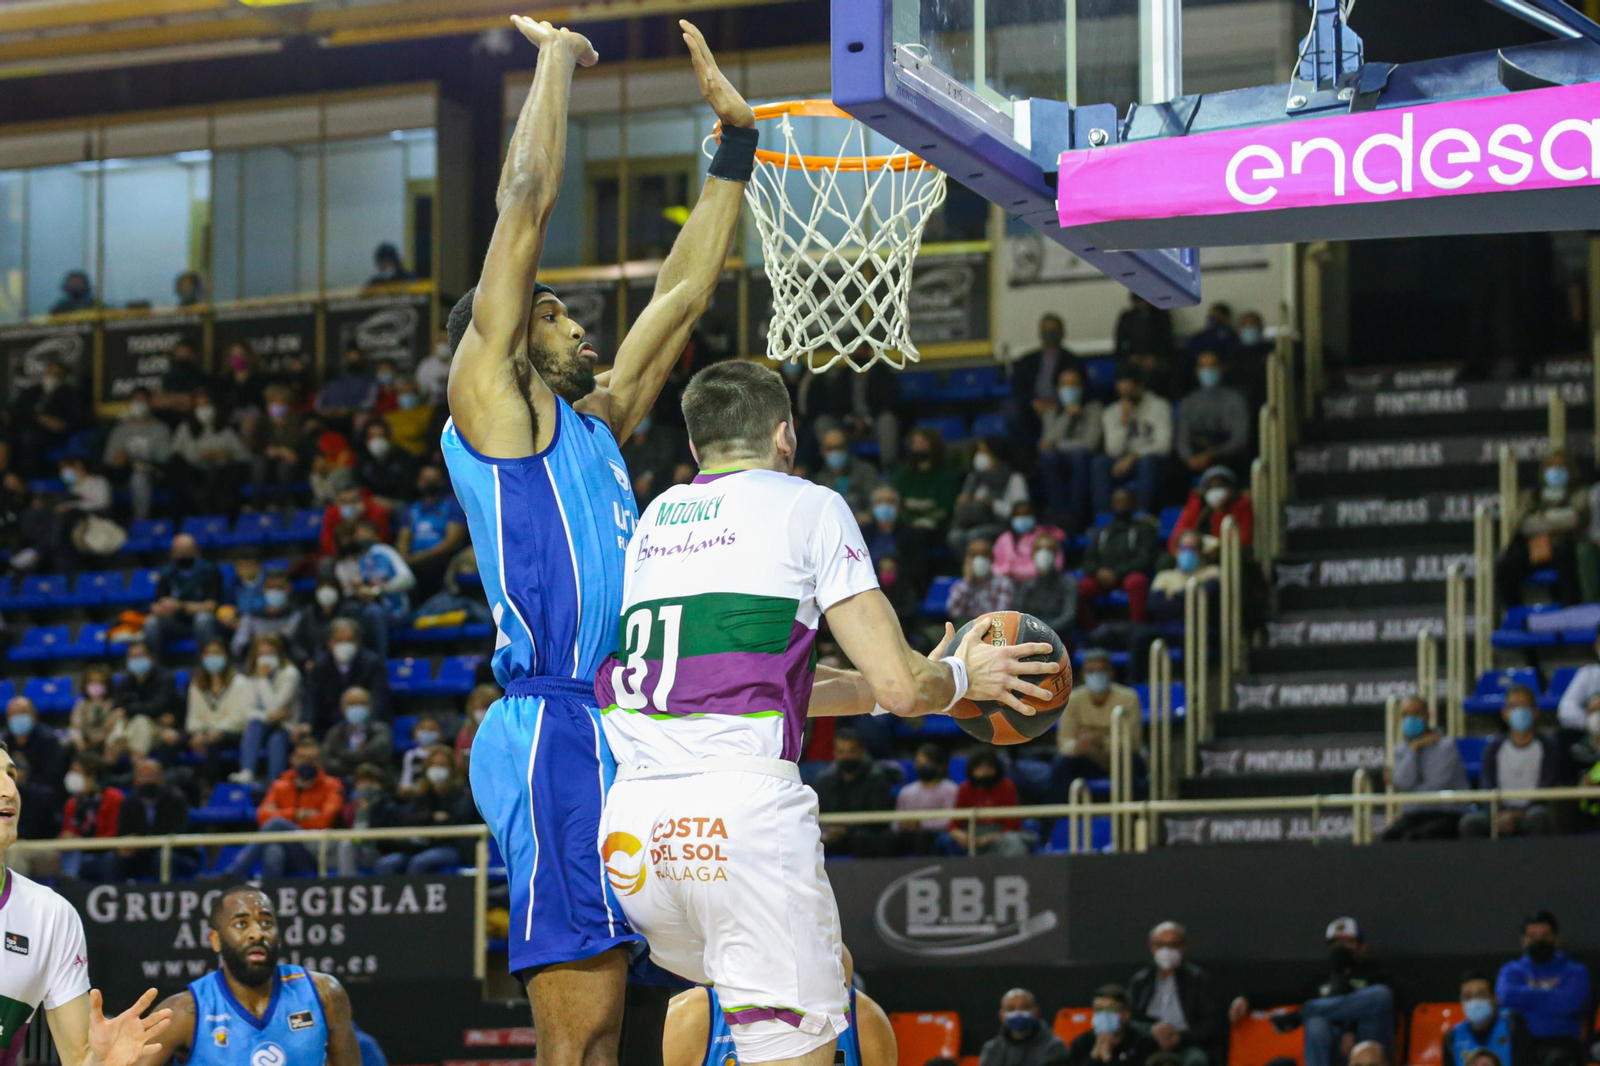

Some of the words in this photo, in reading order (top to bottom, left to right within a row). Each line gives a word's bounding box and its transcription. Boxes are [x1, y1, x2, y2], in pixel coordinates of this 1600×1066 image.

[1225, 112, 1600, 206] endesa
[655, 494, 726, 527] MOONEY
[611, 603, 684, 712] 31
[652, 817, 729, 843] COSTA
[650, 844, 678, 866] DEL
[682, 843, 728, 862] SOL
[248, 880, 448, 918] EGISLAE
